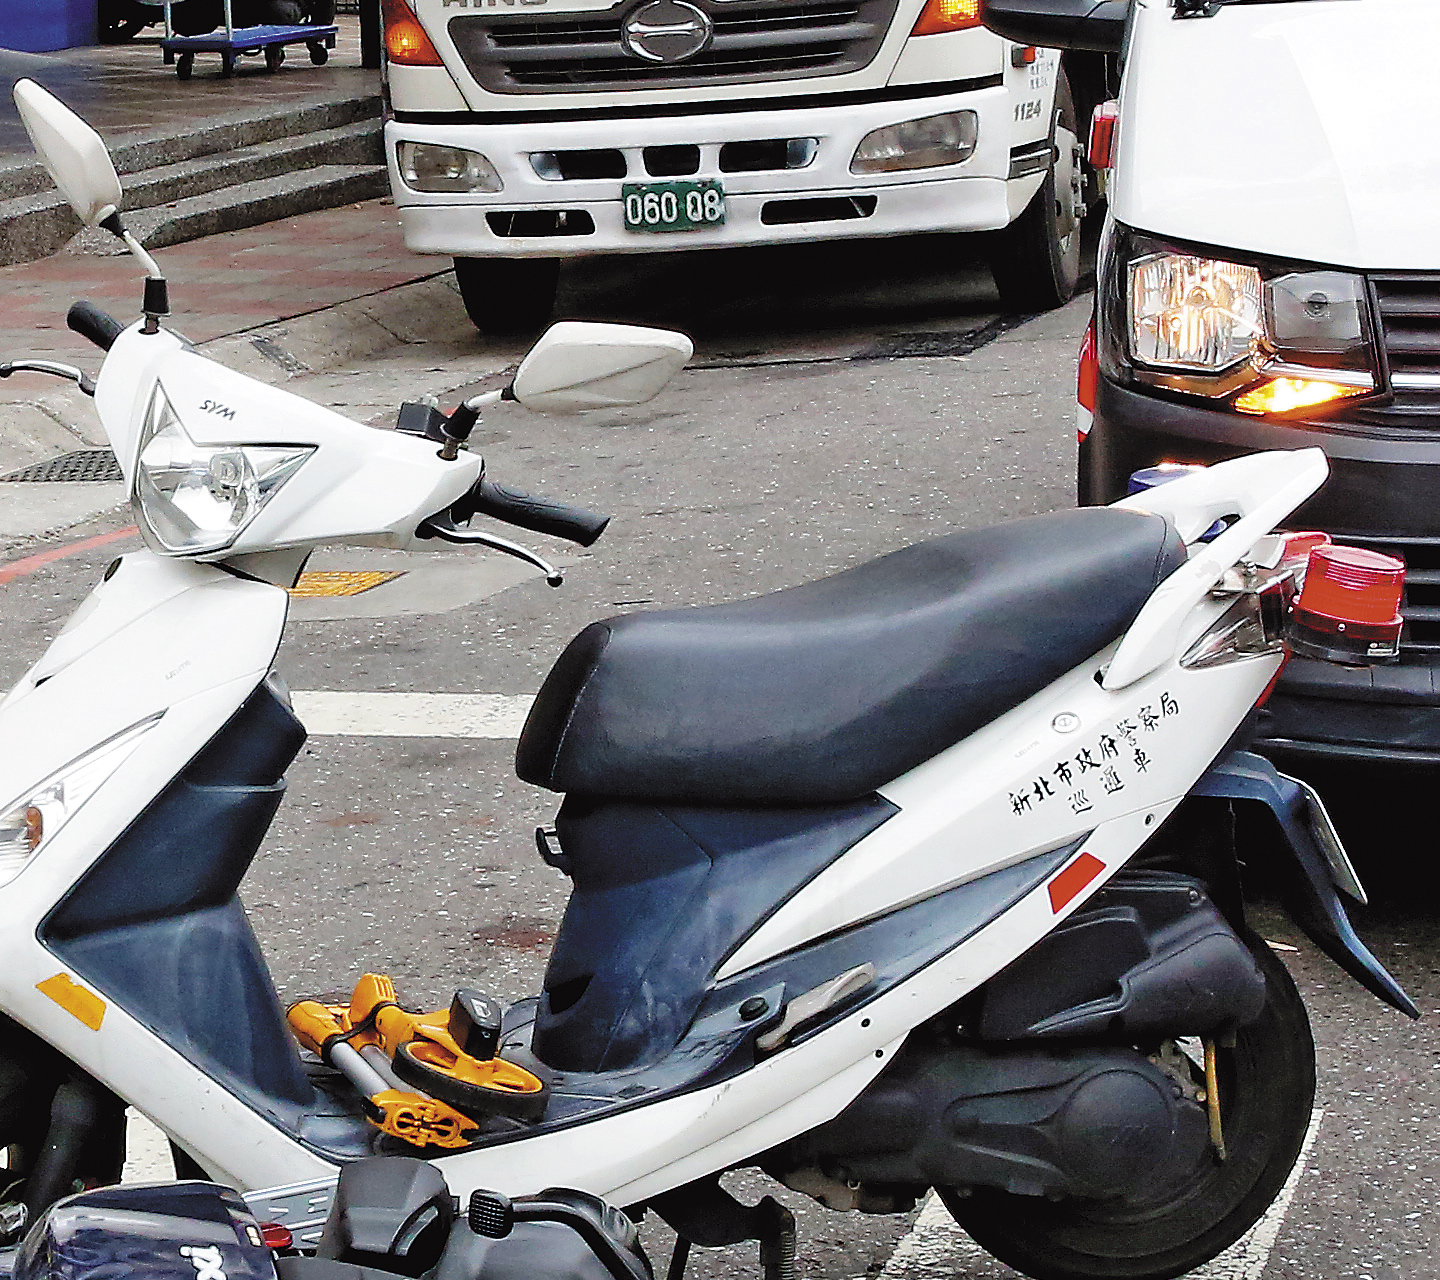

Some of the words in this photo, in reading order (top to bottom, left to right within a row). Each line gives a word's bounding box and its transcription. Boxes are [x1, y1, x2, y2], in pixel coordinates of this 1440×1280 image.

[1014, 99, 1042, 121] 1124
[199, 399, 237, 420] SYM
[1008, 691, 1180, 816] 新北市政府警察局
[1067, 748, 1152, 815] 巡邏車
